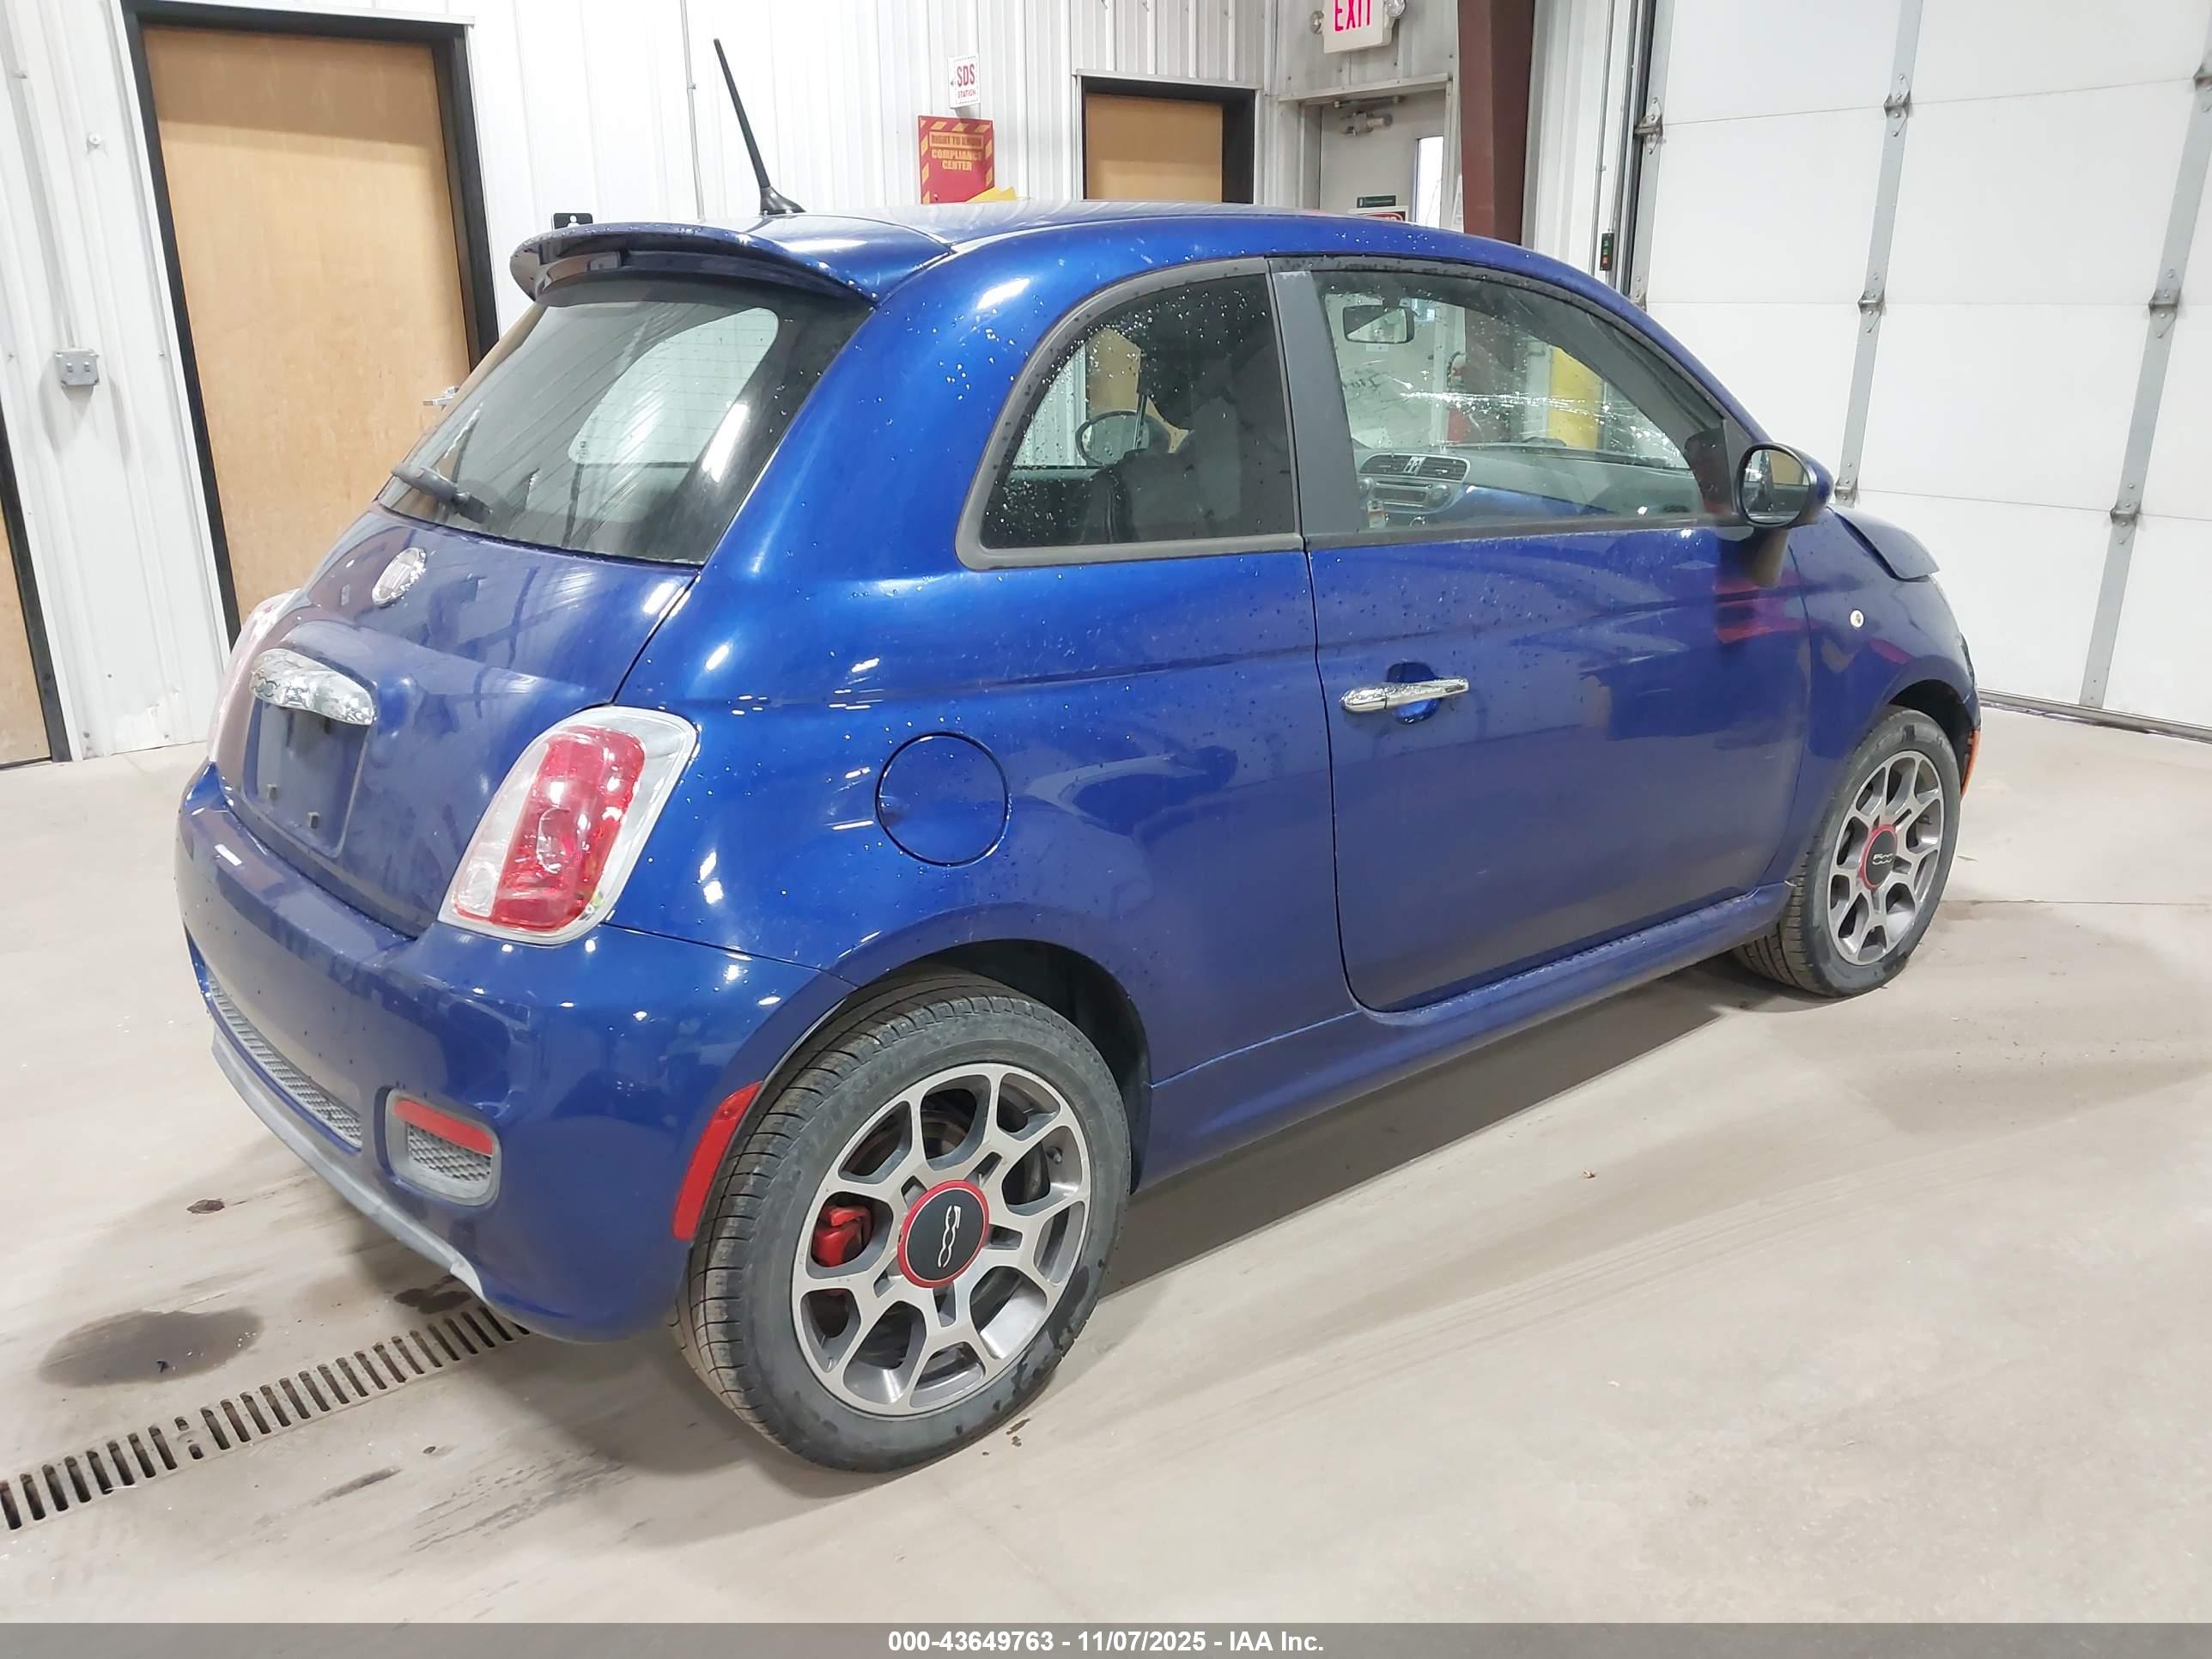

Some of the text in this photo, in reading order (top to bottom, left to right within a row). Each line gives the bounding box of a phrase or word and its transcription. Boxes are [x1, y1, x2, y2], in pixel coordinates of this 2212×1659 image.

[1334, 0, 1370, 31] EXIT
[957, 64, 975, 88] SDS
[957, 88, 976, 99] STATION
[951, 136, 961, 146] TO
[932, 149, 982, 161] COMPLIANCE
[942, 160, 972, 171] CENTER
